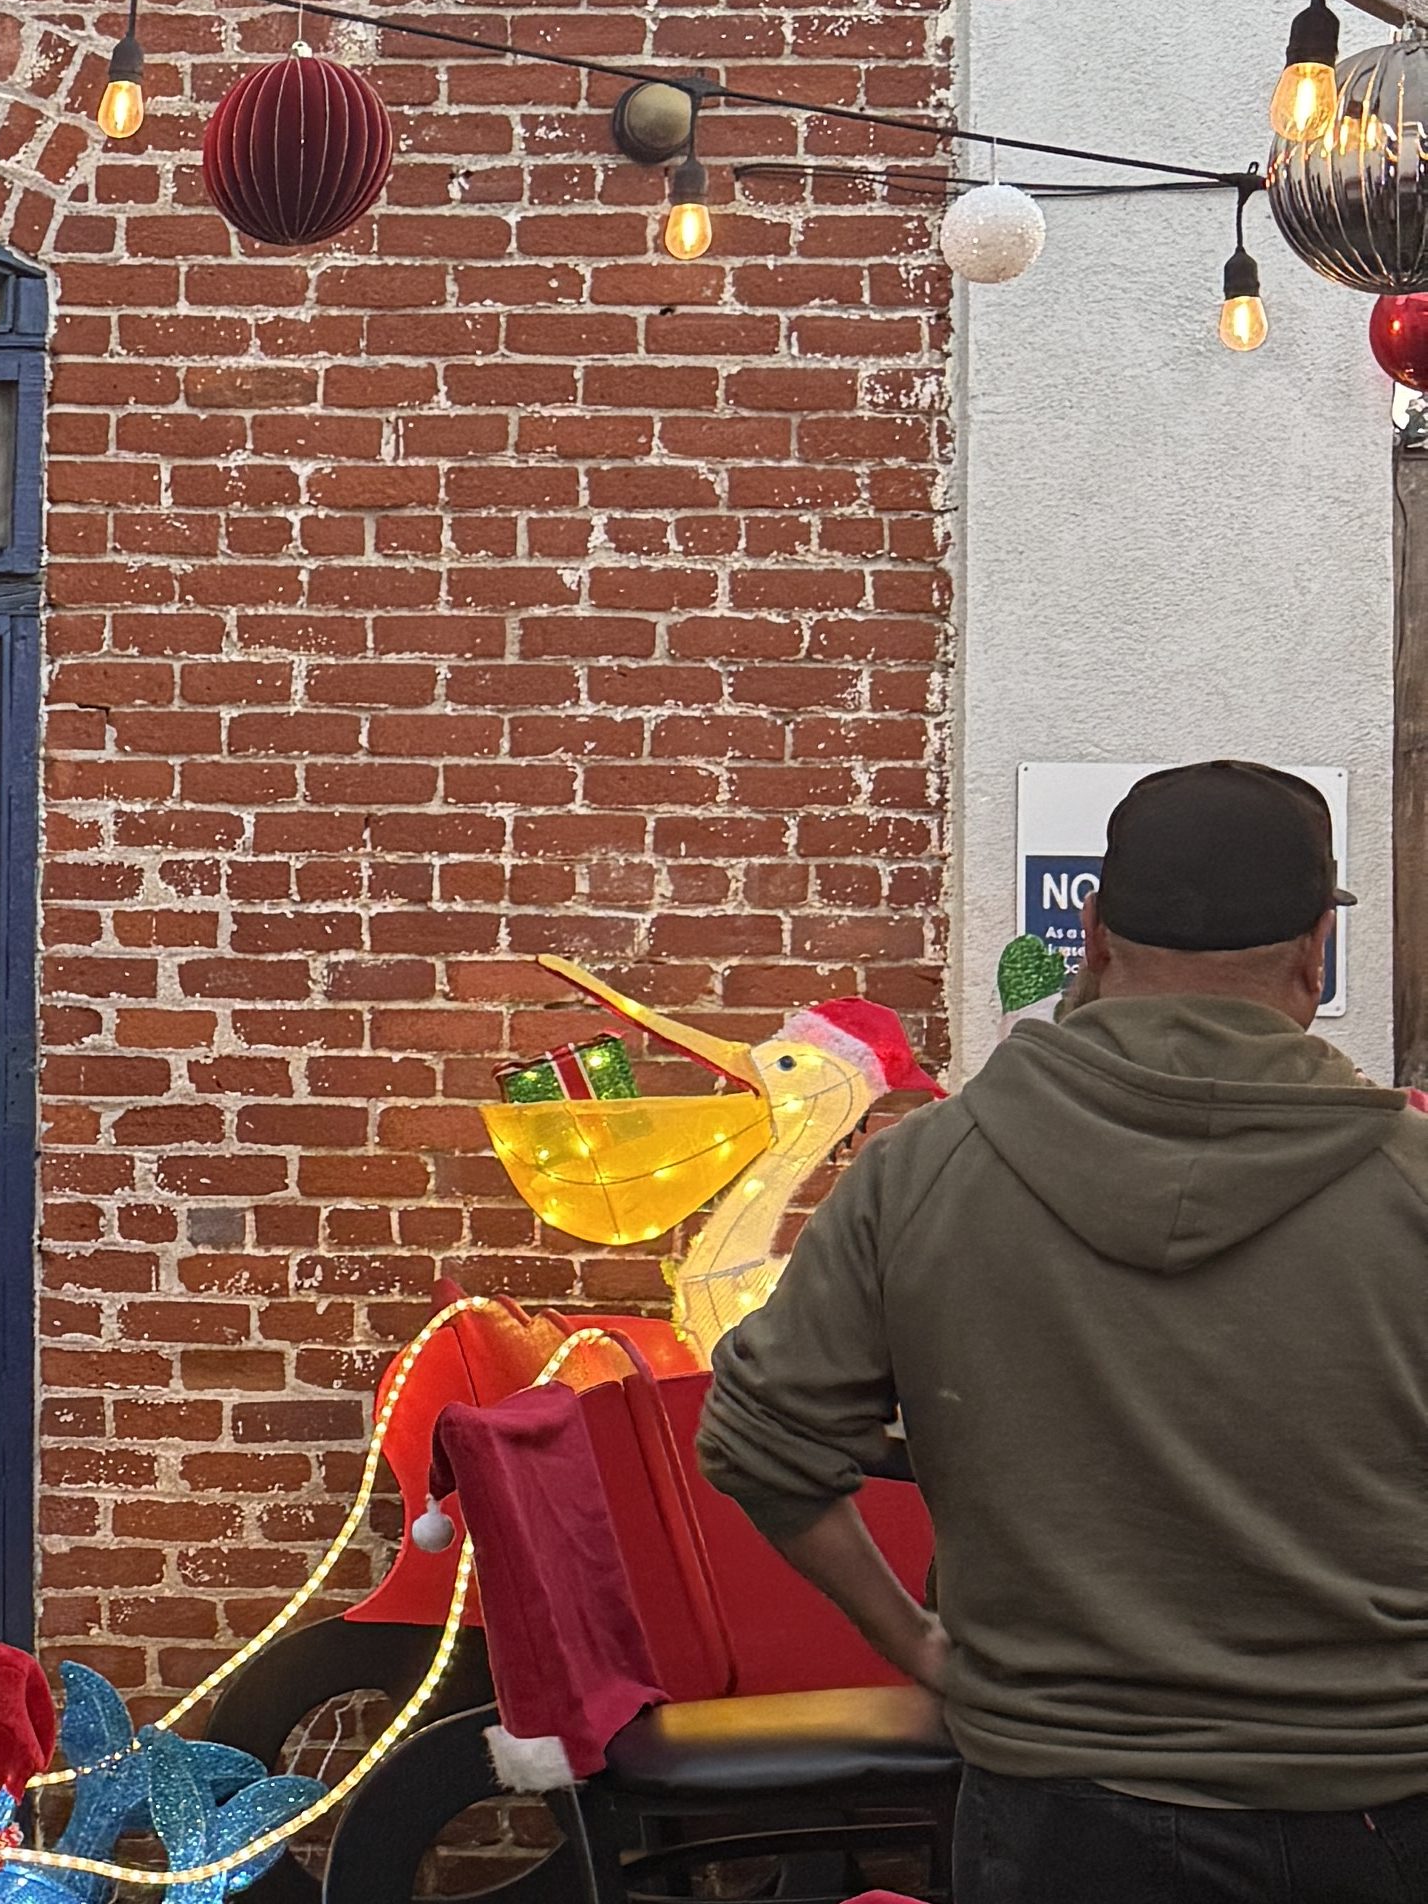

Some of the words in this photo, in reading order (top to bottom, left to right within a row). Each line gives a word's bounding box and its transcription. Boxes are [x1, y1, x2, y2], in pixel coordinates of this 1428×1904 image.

[1042, 872, 1101, 911] NO
[1045, 926, 1064, 939] As
[1066, 928, 1078, 940] a
